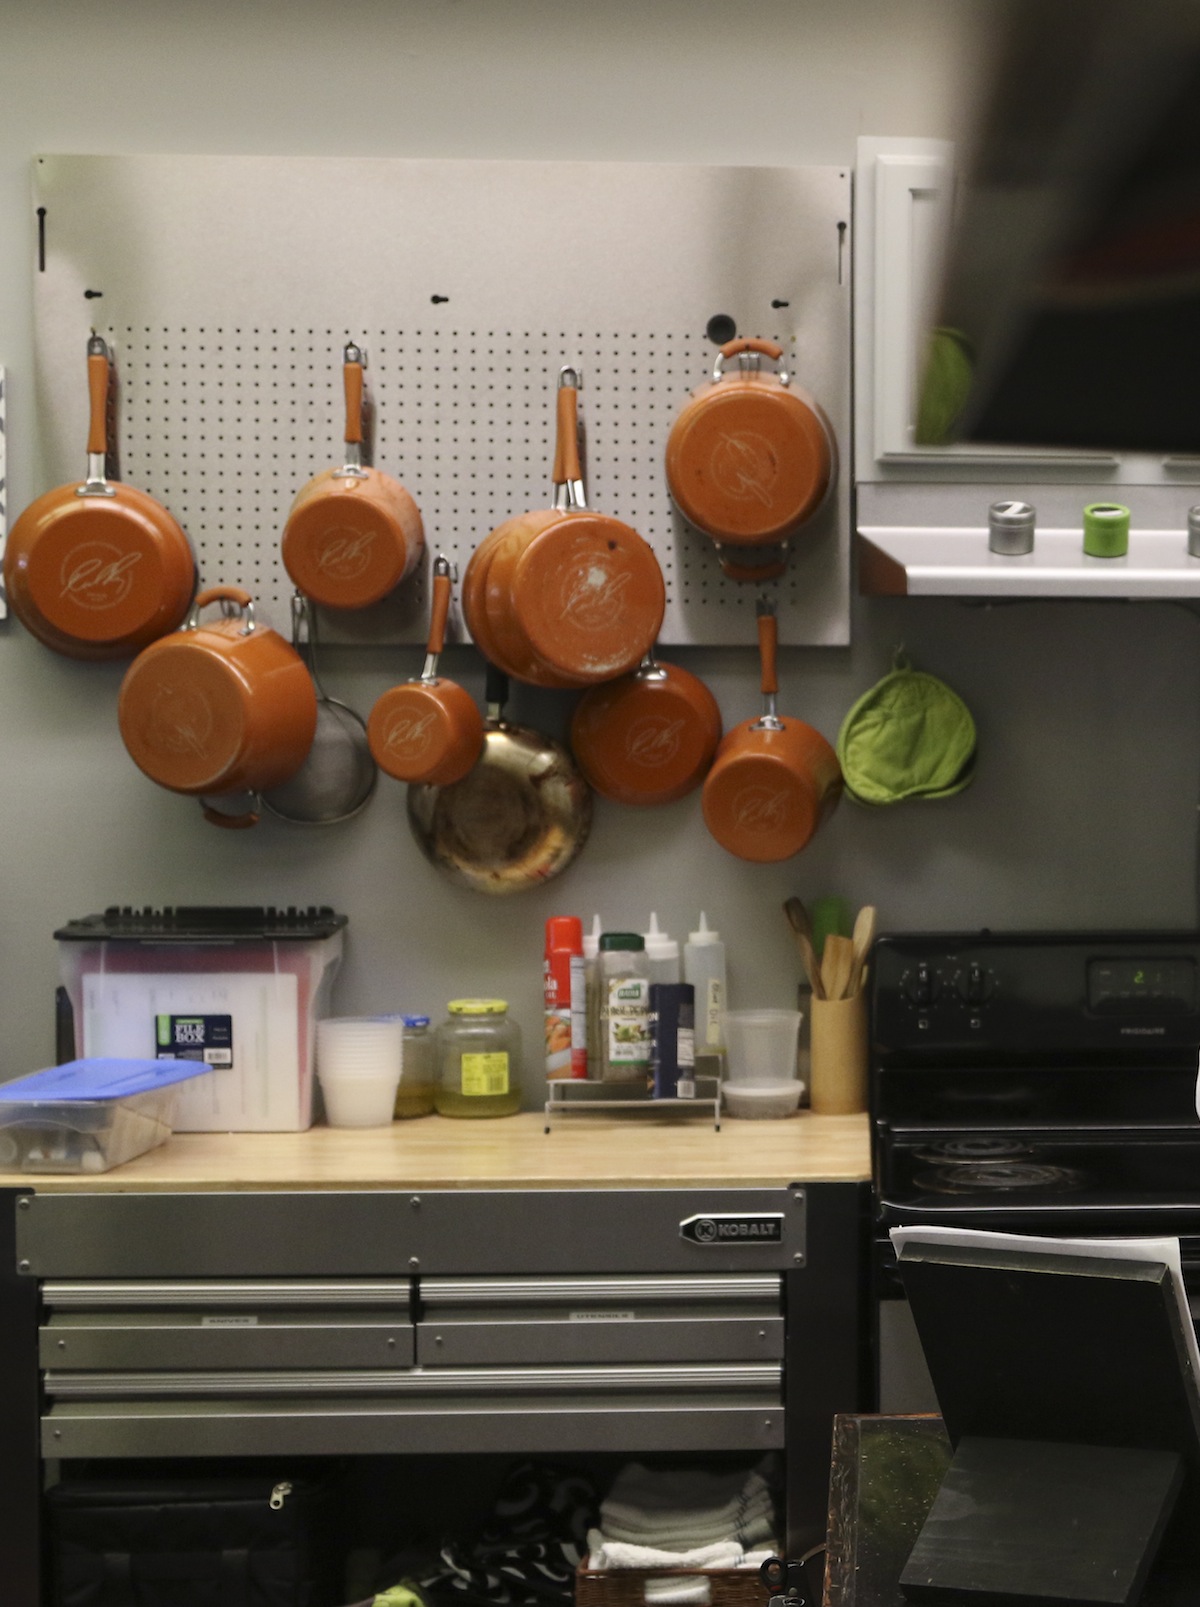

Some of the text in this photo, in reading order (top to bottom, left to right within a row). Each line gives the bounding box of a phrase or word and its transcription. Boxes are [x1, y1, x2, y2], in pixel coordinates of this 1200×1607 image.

[175, 1024, 206, 1034] FILE
[175, 1033, 206, 1043] BOX
[718, 1223, 775, 1236] KOBALT
